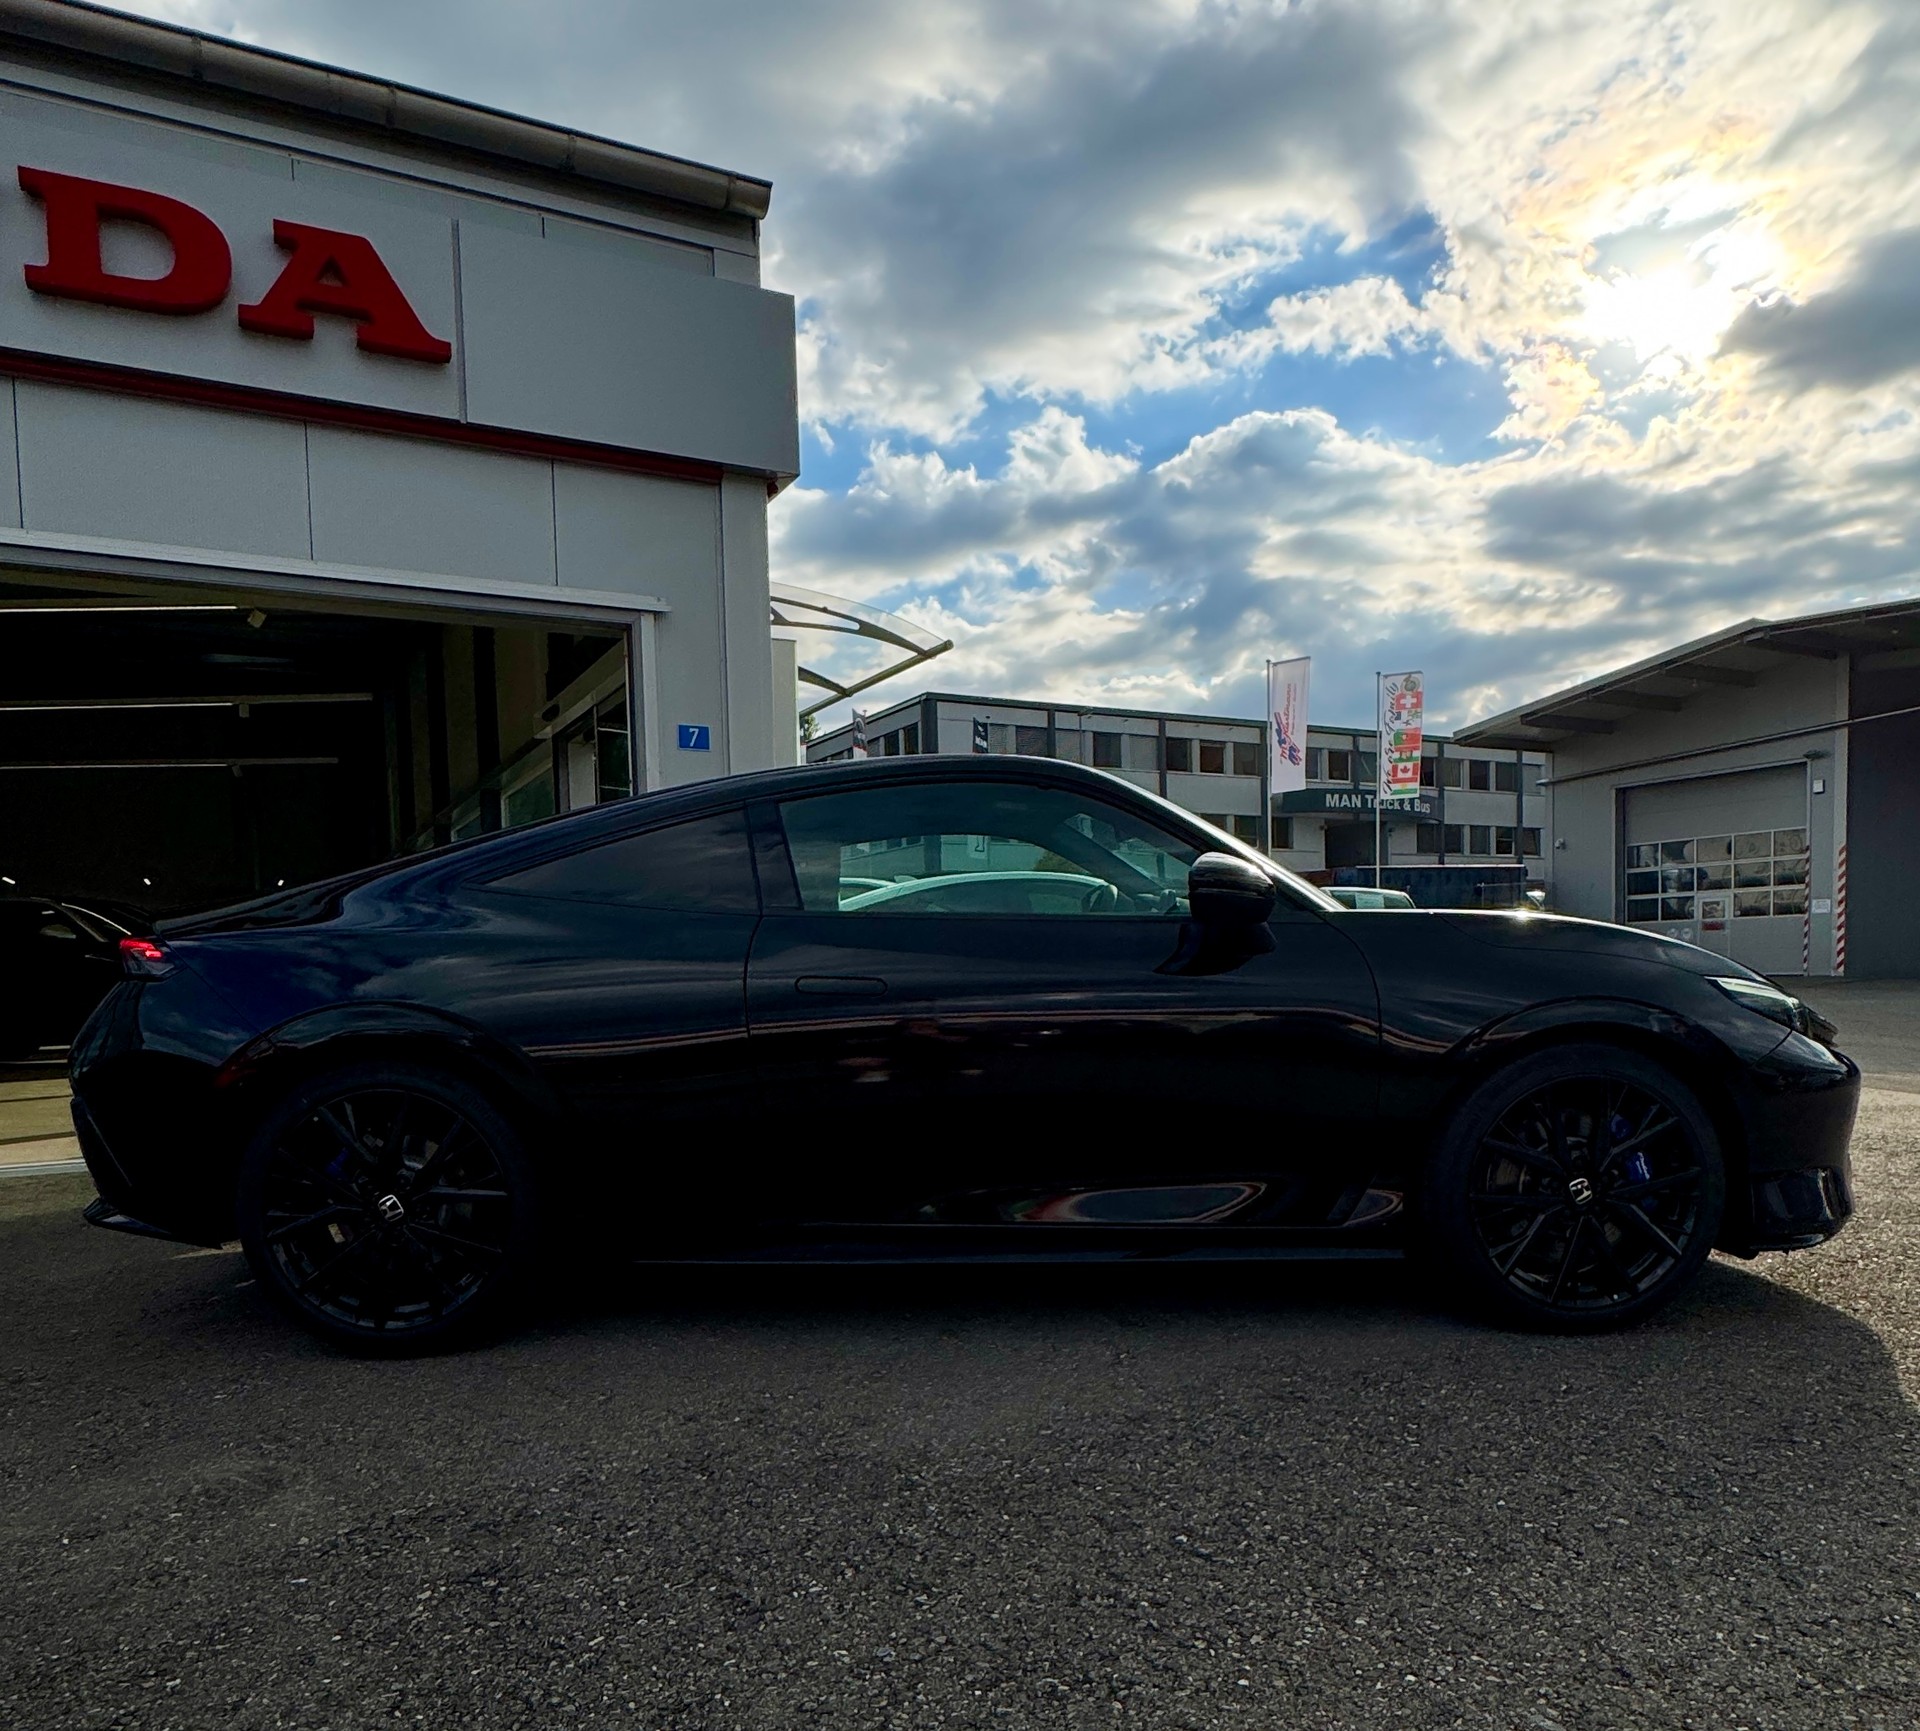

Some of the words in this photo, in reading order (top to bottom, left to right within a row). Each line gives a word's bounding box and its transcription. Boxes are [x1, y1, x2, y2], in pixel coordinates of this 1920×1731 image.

[689, 727, 699, 747] 7
[1325, 793, 1361, 808] MAN
[1403, 798, 1412, 812] &
[1414, 798, 1431, 814] Bus
